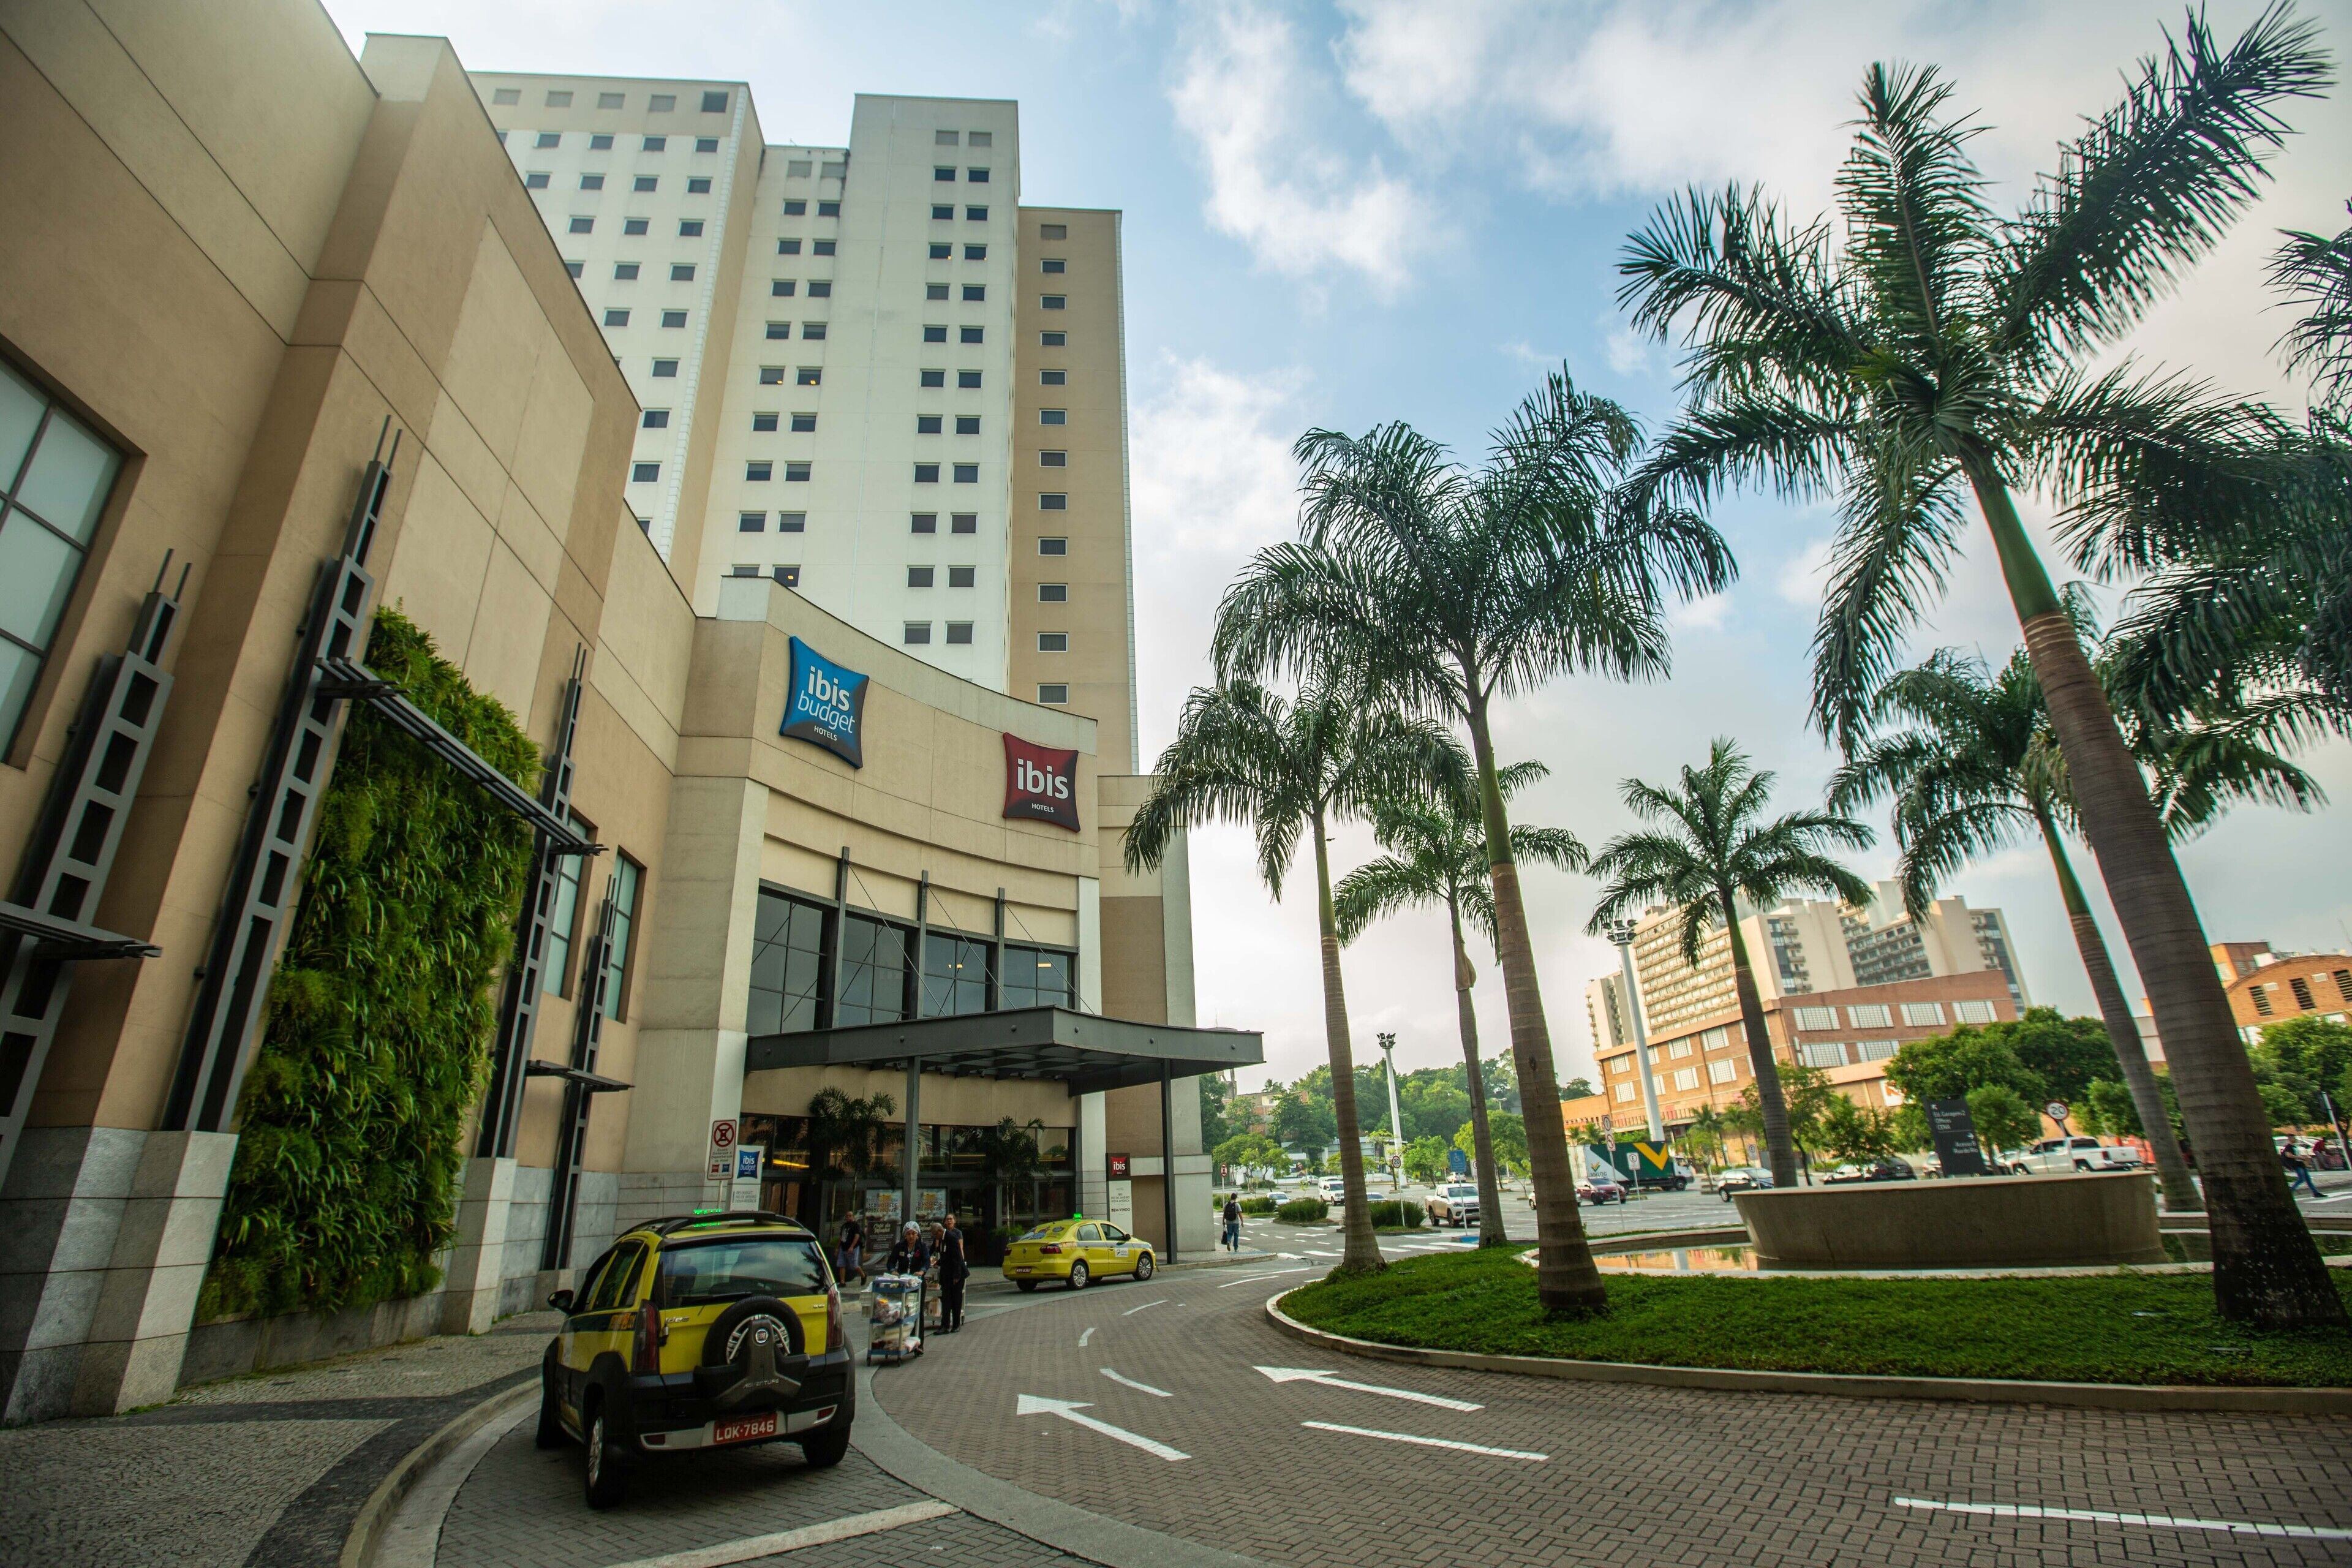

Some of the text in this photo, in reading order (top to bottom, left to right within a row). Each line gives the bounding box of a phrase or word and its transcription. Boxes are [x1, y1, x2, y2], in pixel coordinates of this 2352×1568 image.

[808, 665, 850, 711] ibis
[797, 690, 855, 734] budget
[814, 725, 837, 741] HOTELS
[1017, 758, 1069, 799] ibis
[1031, 803, 1054, 813] HOTELS
[2051, 1106, 2065, 1115] 20
[742, 1156, 755, 1164] ibis
[1113, 1161, 1126, 1170] ibis
